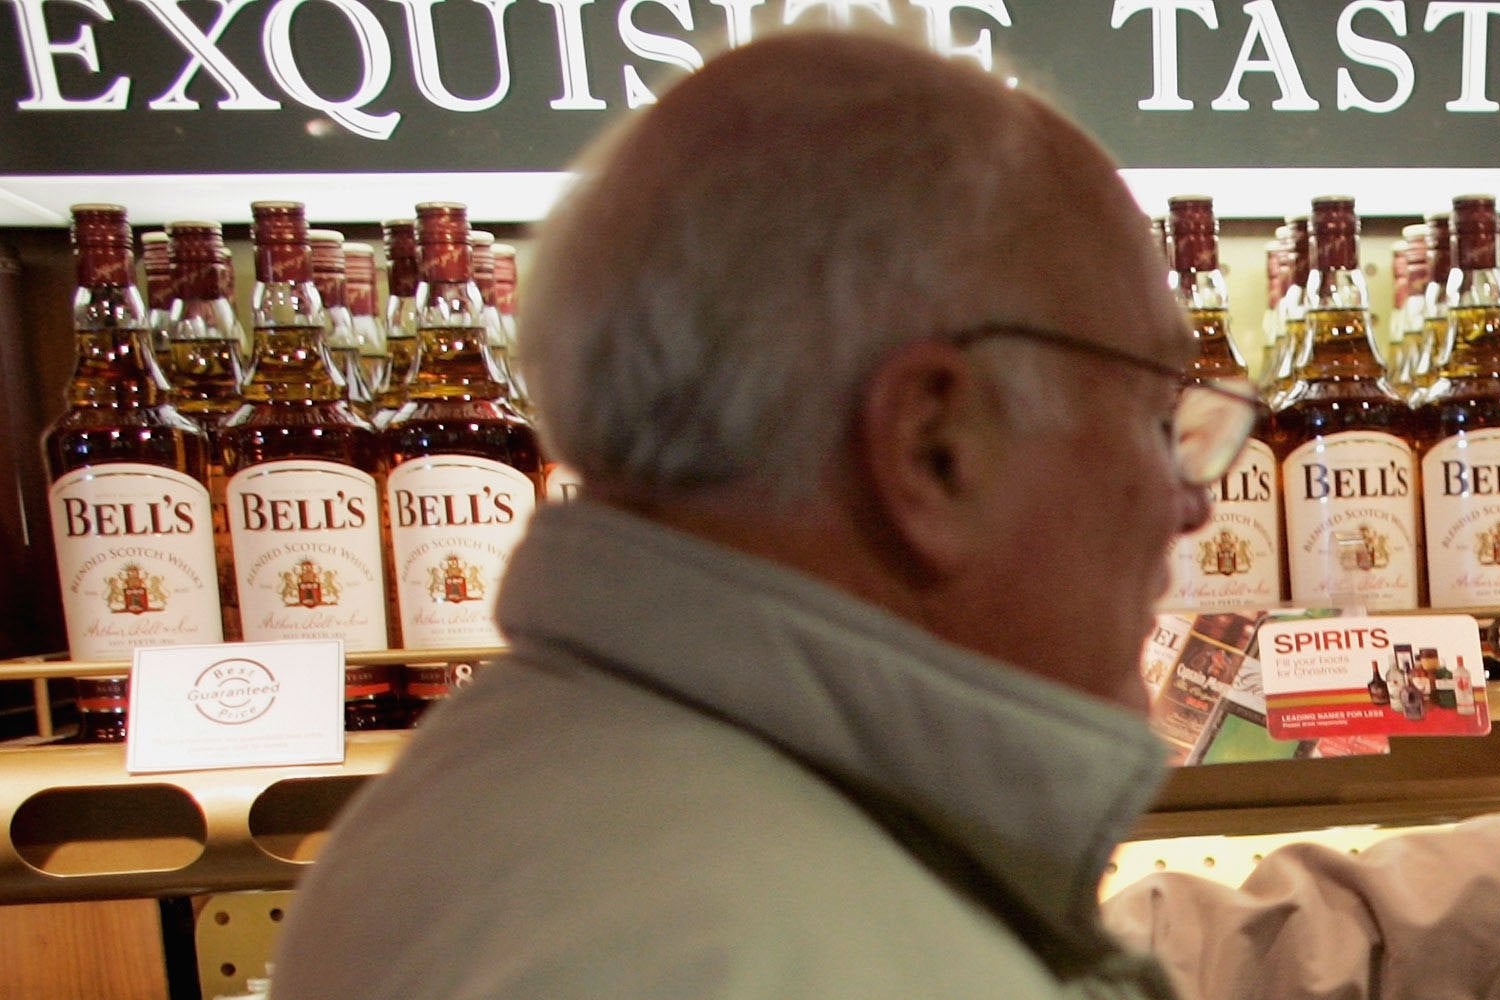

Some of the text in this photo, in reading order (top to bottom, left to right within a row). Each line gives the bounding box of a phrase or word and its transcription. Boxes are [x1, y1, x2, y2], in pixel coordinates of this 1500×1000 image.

[17, 0, 1012, 140] EXQUISE
[1302, 460, 1409, 500] BELL'S
[62, 494, 196, 538] BELL'S
[239, 489, 367, 533] BELL'S
[395, 485, 515, 528] BELL'S
[1274, 627, 1390, 654] SPIRITS
[187, 681, 280, 703] Guaranteed
